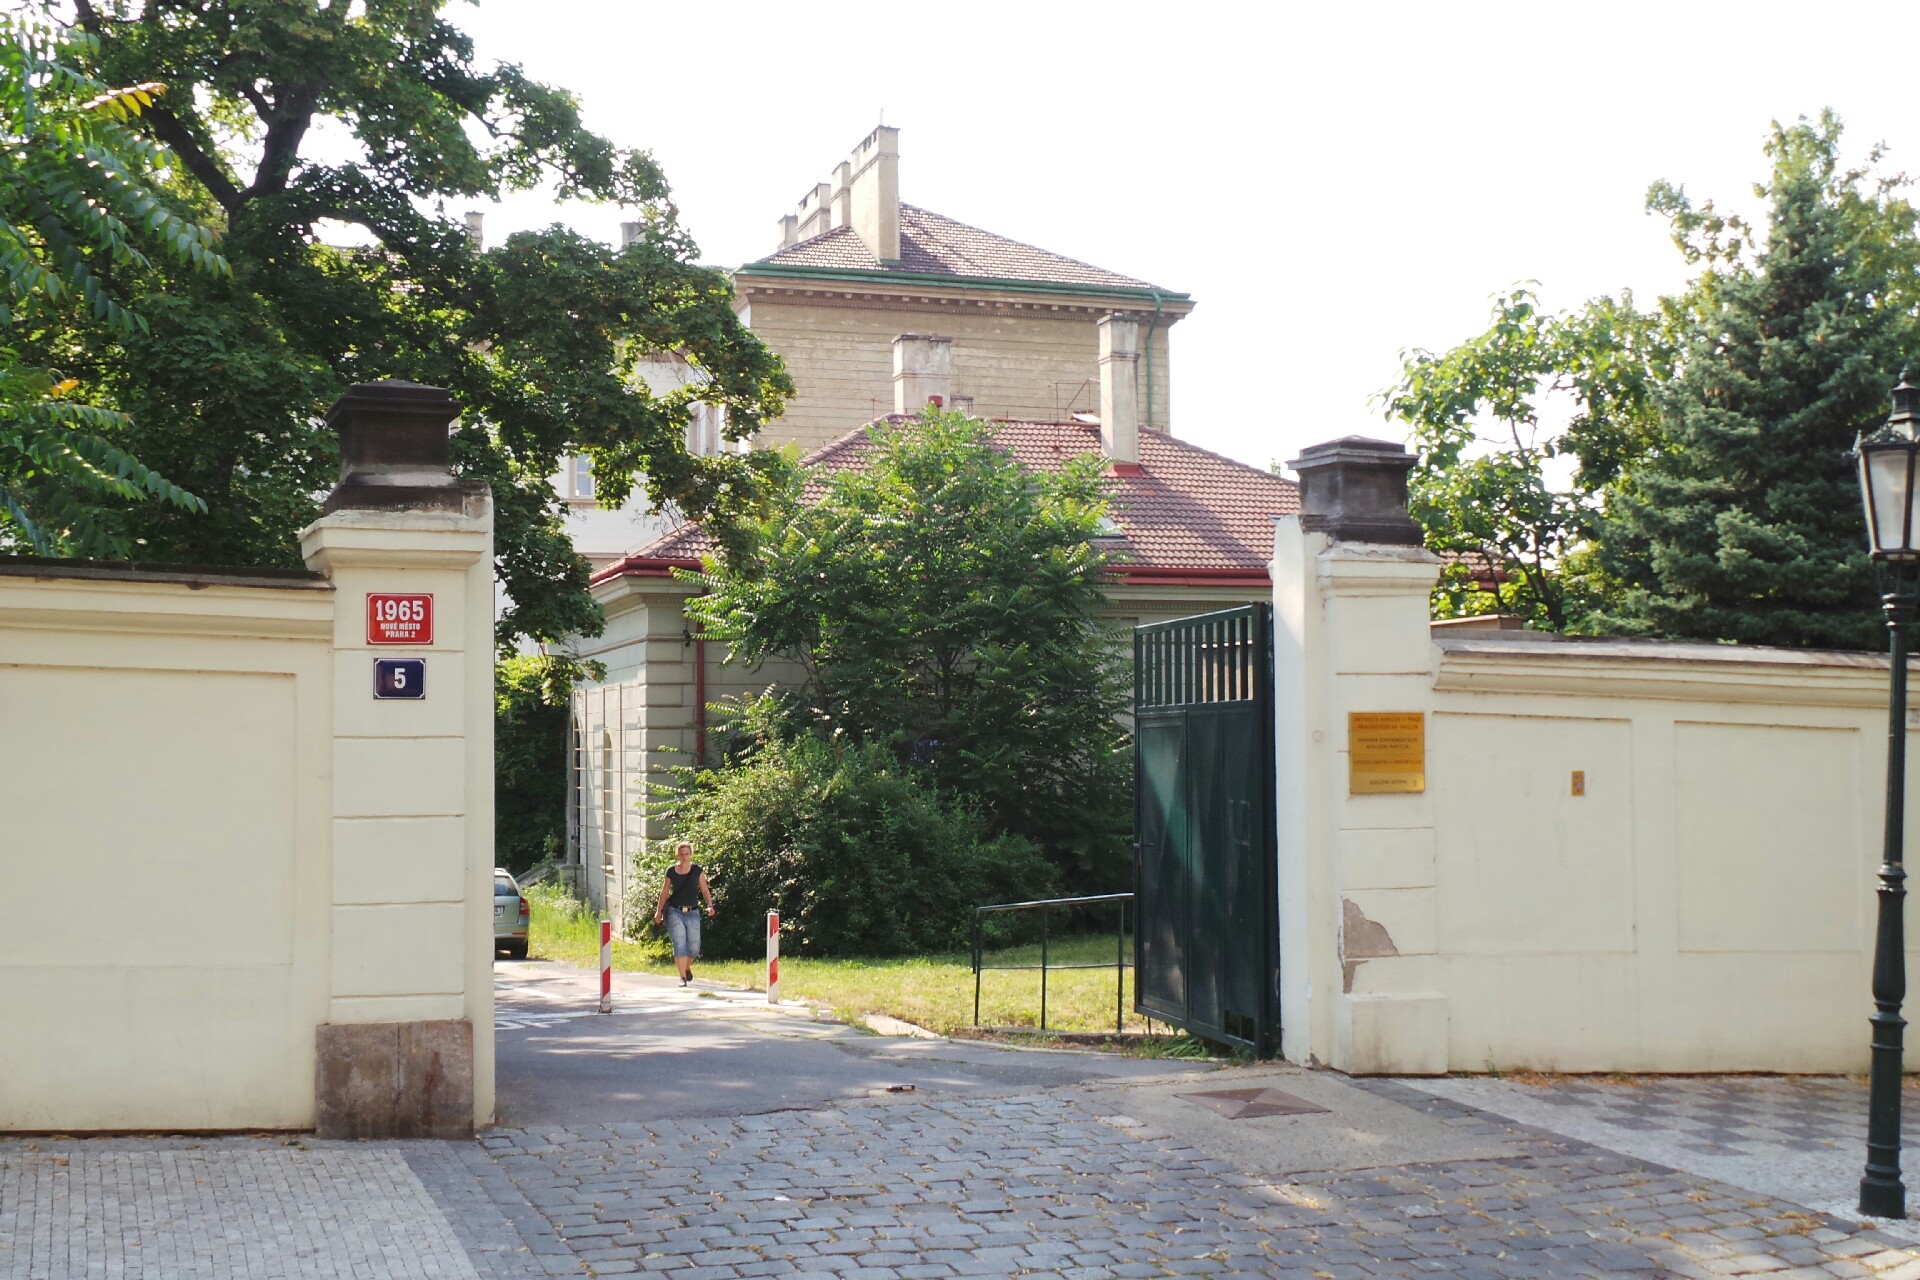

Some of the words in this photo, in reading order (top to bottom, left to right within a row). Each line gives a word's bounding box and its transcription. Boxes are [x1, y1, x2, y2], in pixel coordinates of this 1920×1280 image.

[376, 599, 424, 621] 1965
[380, 622, 398, 630] NOVÉ
[394, 667, 406, 689] 5
